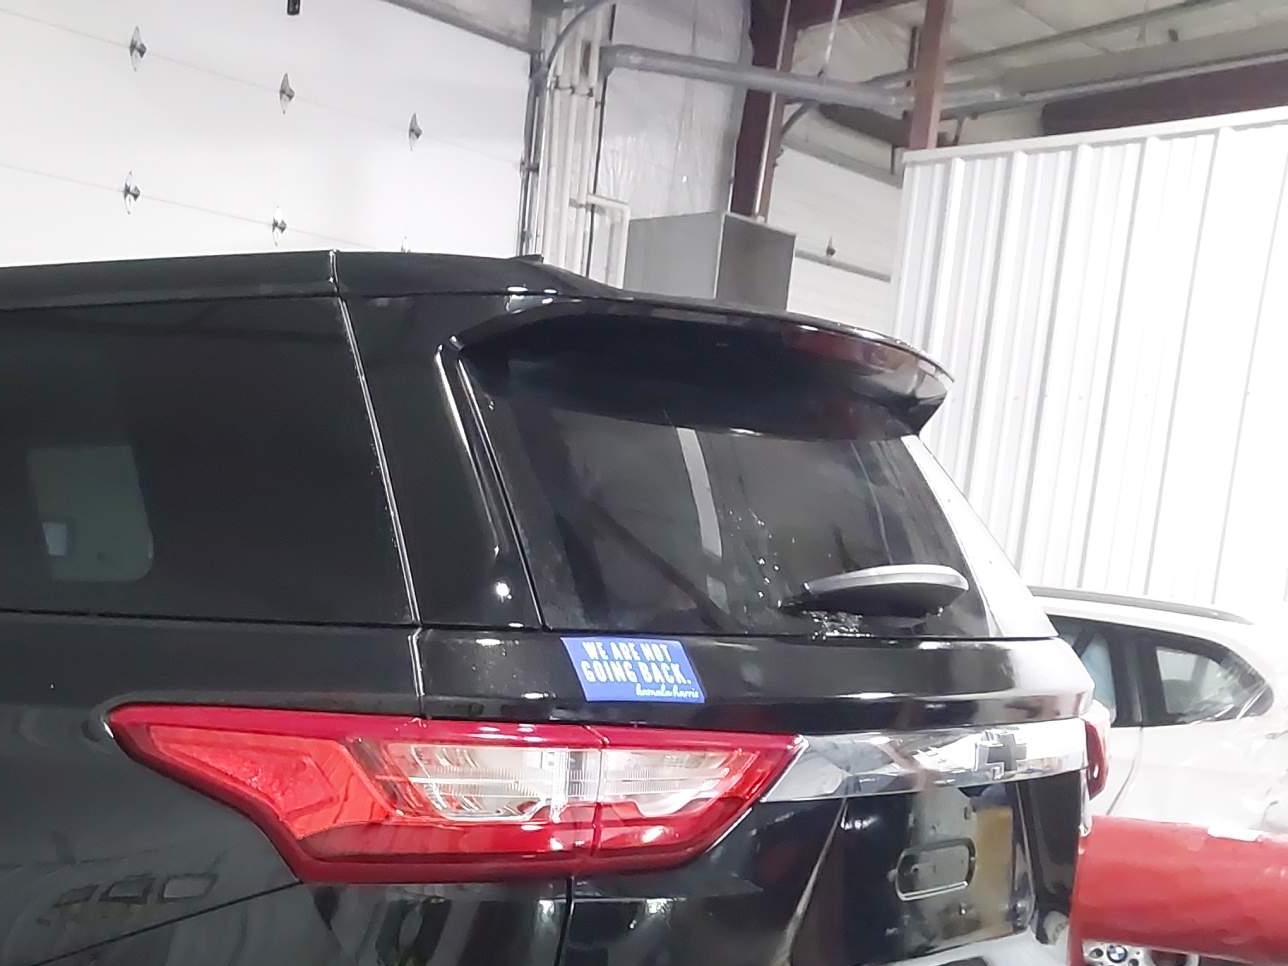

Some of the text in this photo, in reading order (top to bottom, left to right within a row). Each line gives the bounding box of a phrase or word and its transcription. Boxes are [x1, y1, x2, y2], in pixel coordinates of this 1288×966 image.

[582, 641, 671, 662] WE ARE NOT
[581, 660, 691, 685] GOING BACK.
